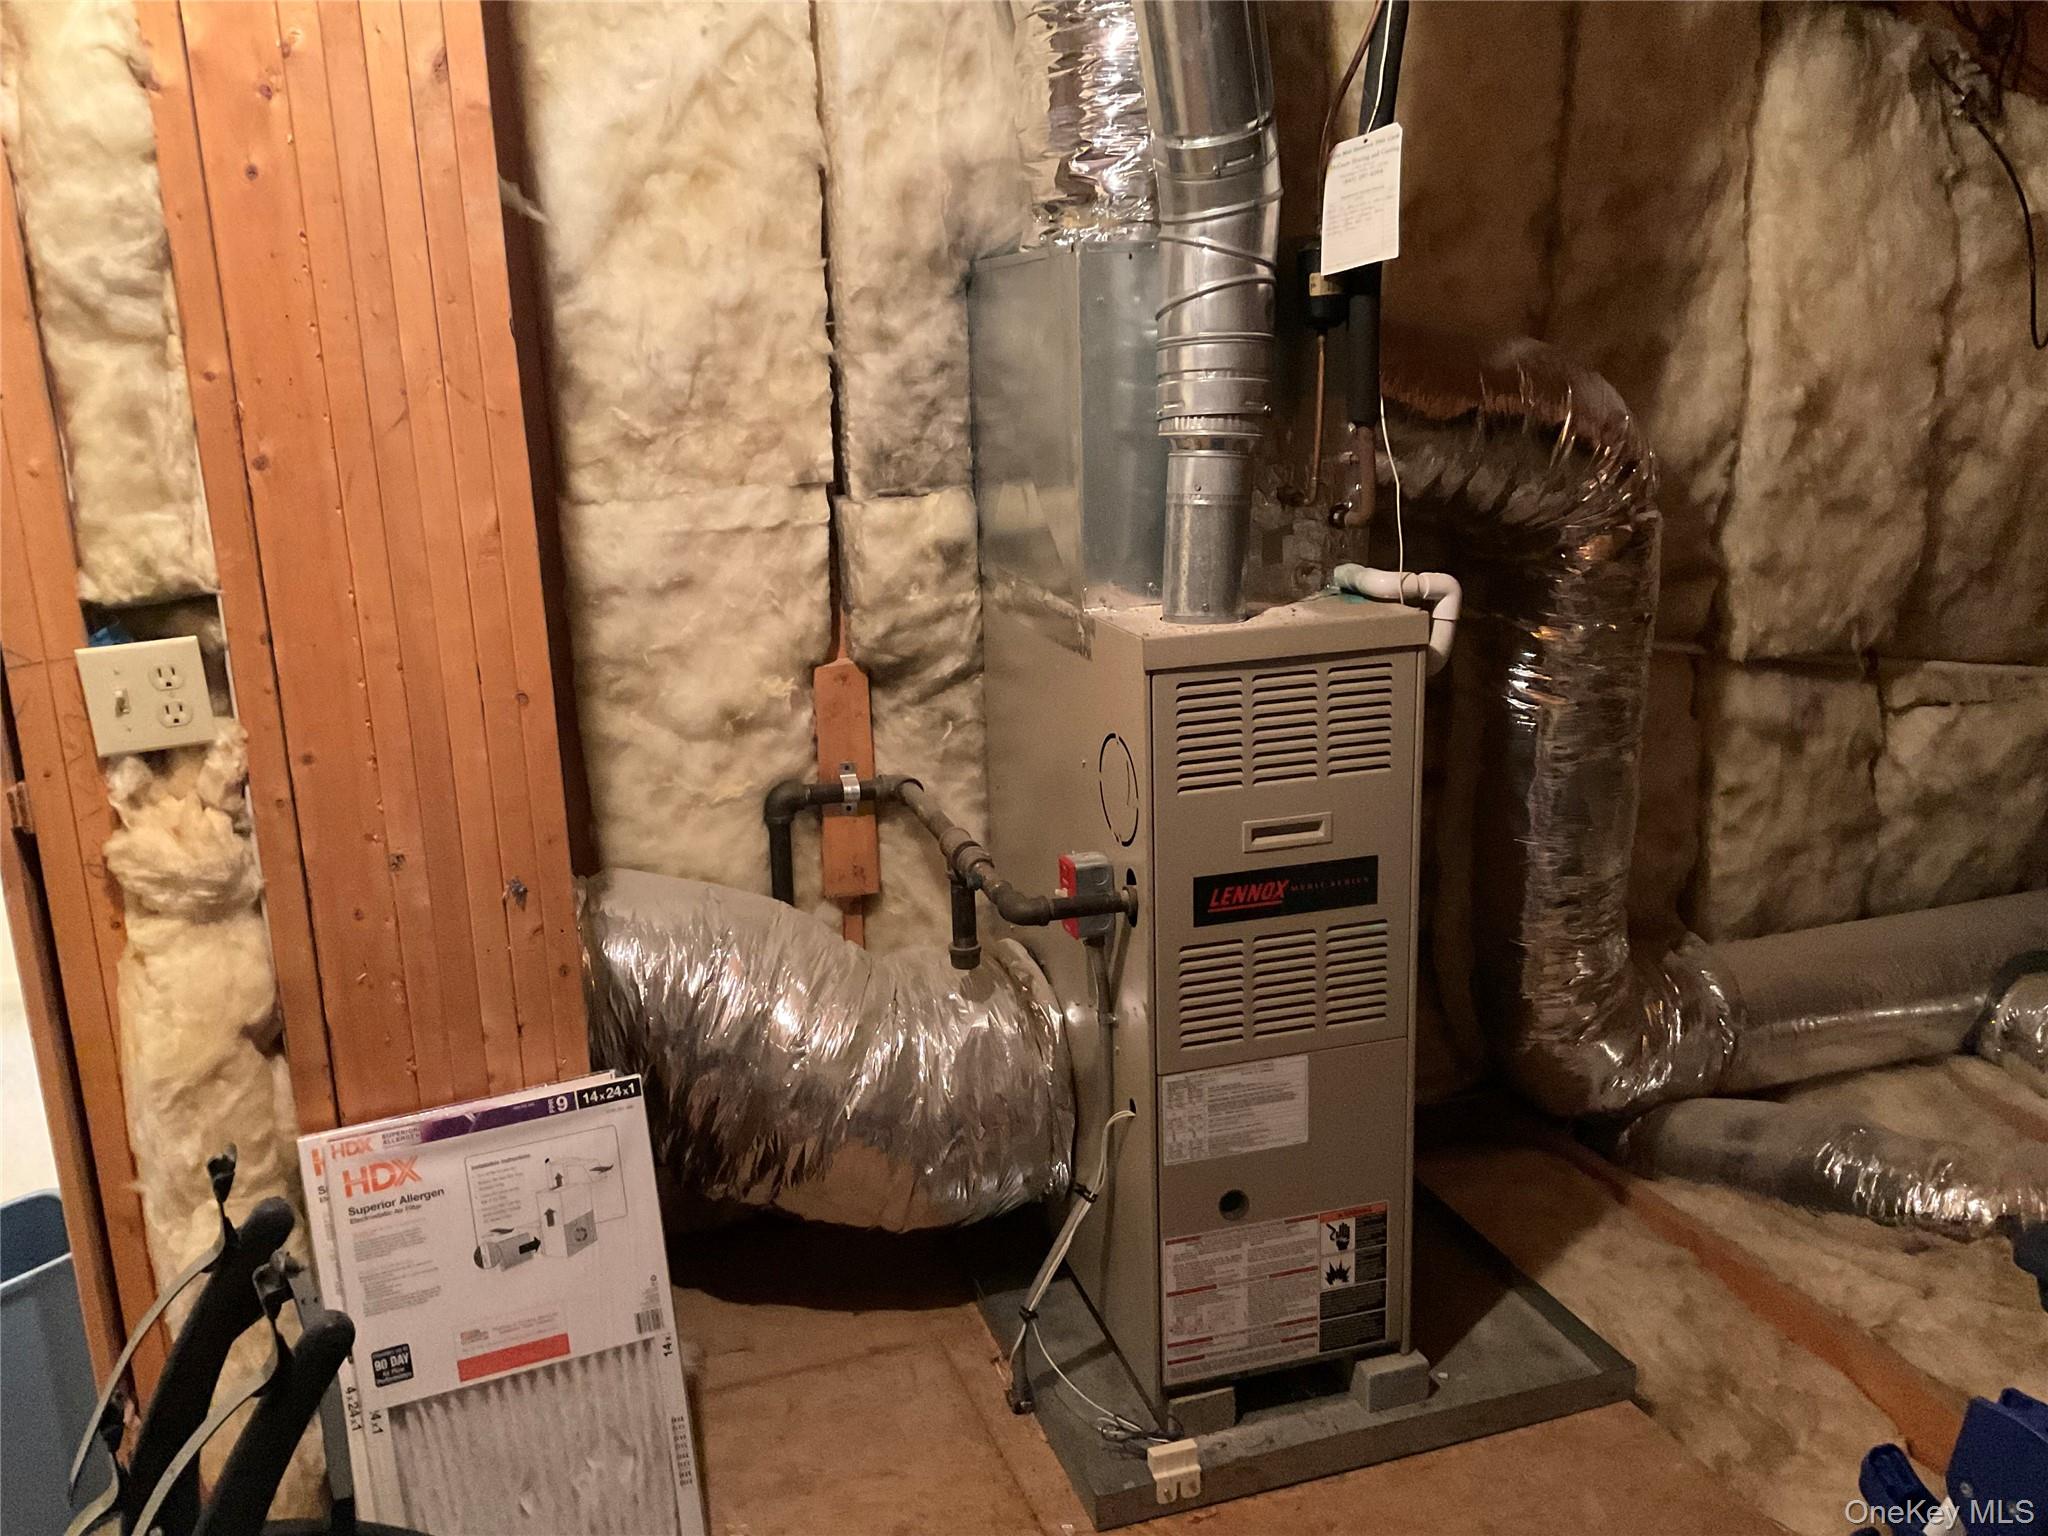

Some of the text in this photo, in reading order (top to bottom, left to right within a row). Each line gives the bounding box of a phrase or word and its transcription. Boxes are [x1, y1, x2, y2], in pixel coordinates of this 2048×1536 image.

[1209, 879, 1290, 907] LENNOX
[556, 1095, 569, 1112] 9
[582, 1083, 635, 1104] 14x24x1
[331, 1137, 374, 1160] HDX
[342, 1154, 423, 1199] HDX
[348, 1198, 396, 1217] Superior
[400, 1188, 445, 1205] Allergen
[390, 1352, 409, 1368] DAY
